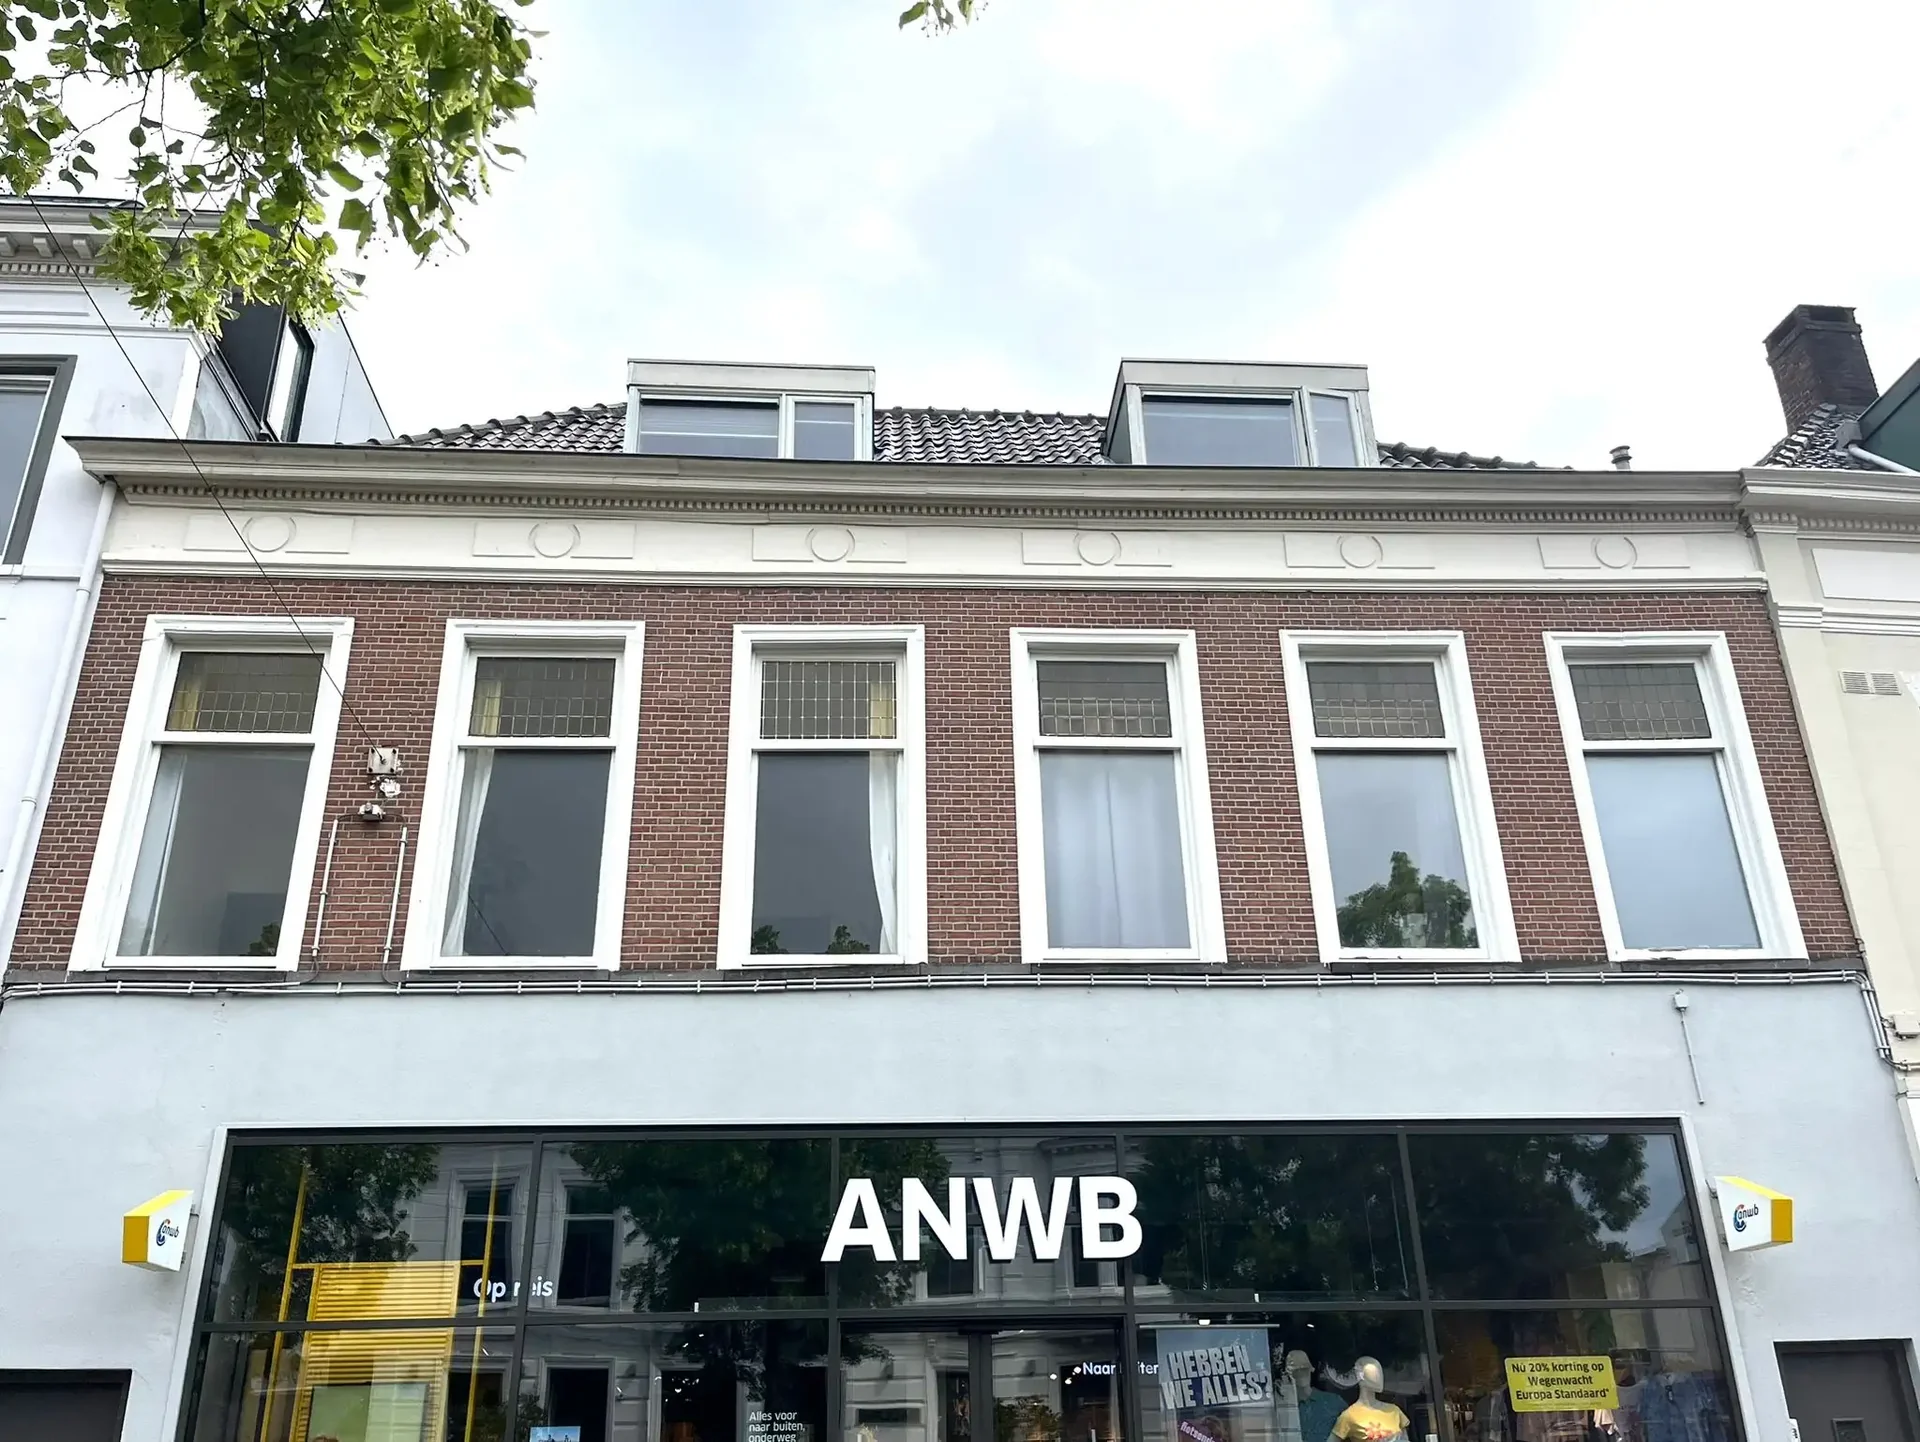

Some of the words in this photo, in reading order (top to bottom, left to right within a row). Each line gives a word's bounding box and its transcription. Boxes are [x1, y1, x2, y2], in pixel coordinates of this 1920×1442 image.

[820, 1176, 1143, 1262] ANWB
[473, 1278, 507, 1303] Op
[1082, 1361, 1116, 1375] Naar
[1167, 1345, 1251, 1380] HEBBEN
[1528, 1362, 1550, 1373] 20%
[1551, 1361, 1590, 1373] korting
[1591, 1362, 1605, 1373] op
[1527, 1375, 1594, 1387] Wegenwacht
[1160, 1379, 1197, 1410] WE
[1201, 1370, 1273, 1406] ALLES?
[1515, 1390, 1553, 1401] Europa
[748, 1411, 773, 1421] Alles
[774, 1412, 798, 1421] voor
[748, 1422, 771, 1432] naar
[772, 1421, 806, 1432] buiten,
[748, 1432, 797, 1442] onderweg
